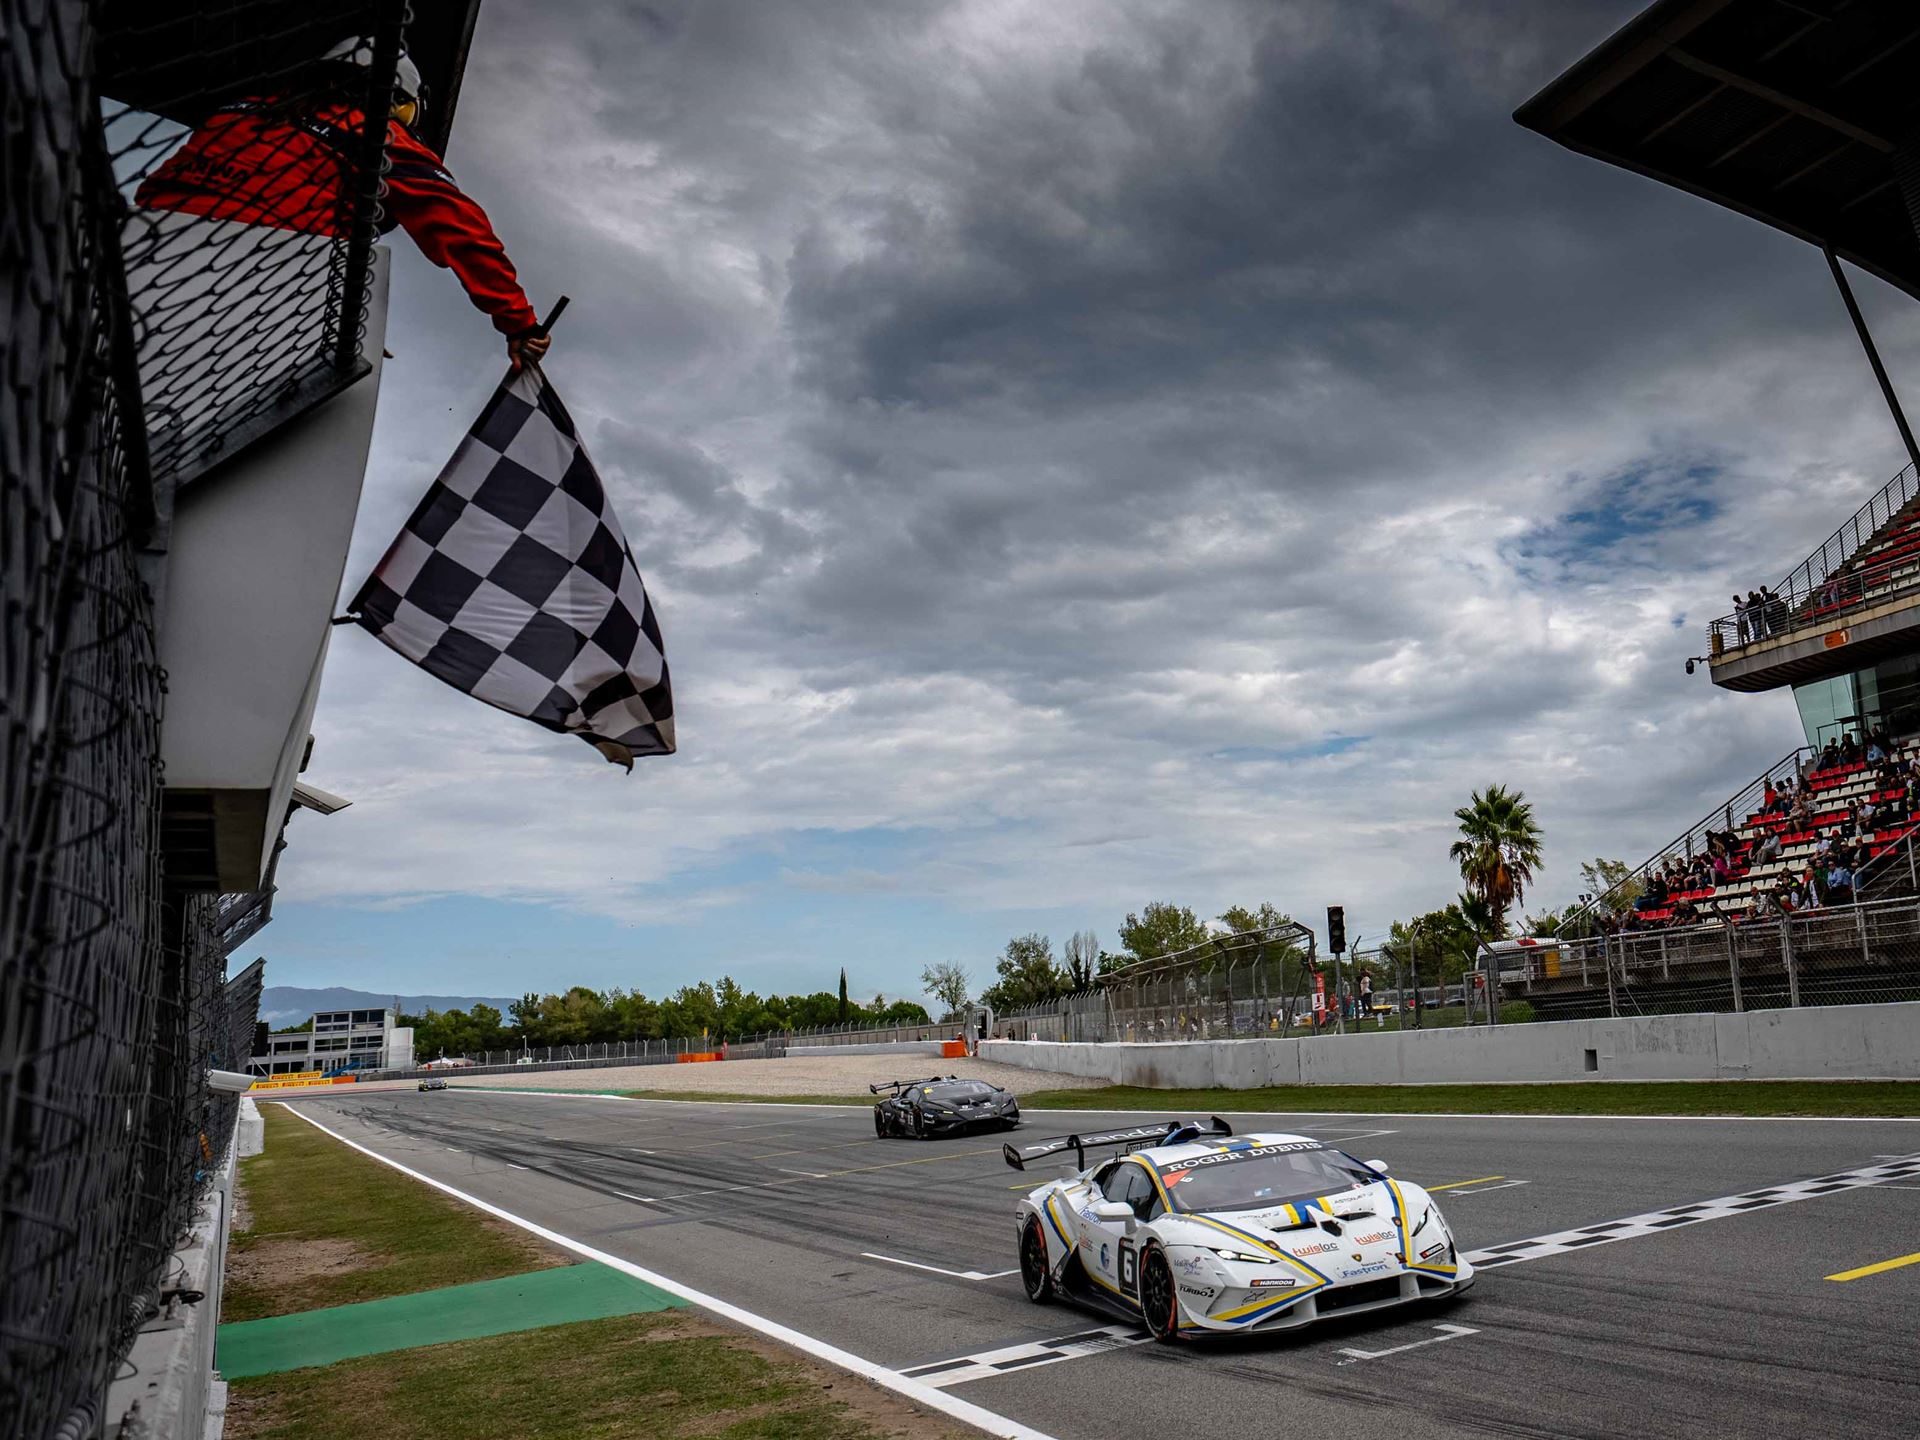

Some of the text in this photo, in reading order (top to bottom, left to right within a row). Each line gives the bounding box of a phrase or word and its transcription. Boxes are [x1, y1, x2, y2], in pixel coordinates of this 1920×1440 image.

[1840, 631, 1847, 643] 1
[1082, 1121, 1206, 1144] randstd
[1167, 1142, 1323, 1172] ROGER DUBUIS
[1123, 1250, 1133, 1284] 6
[1342, 1263, 1388, 1278] Fastron
